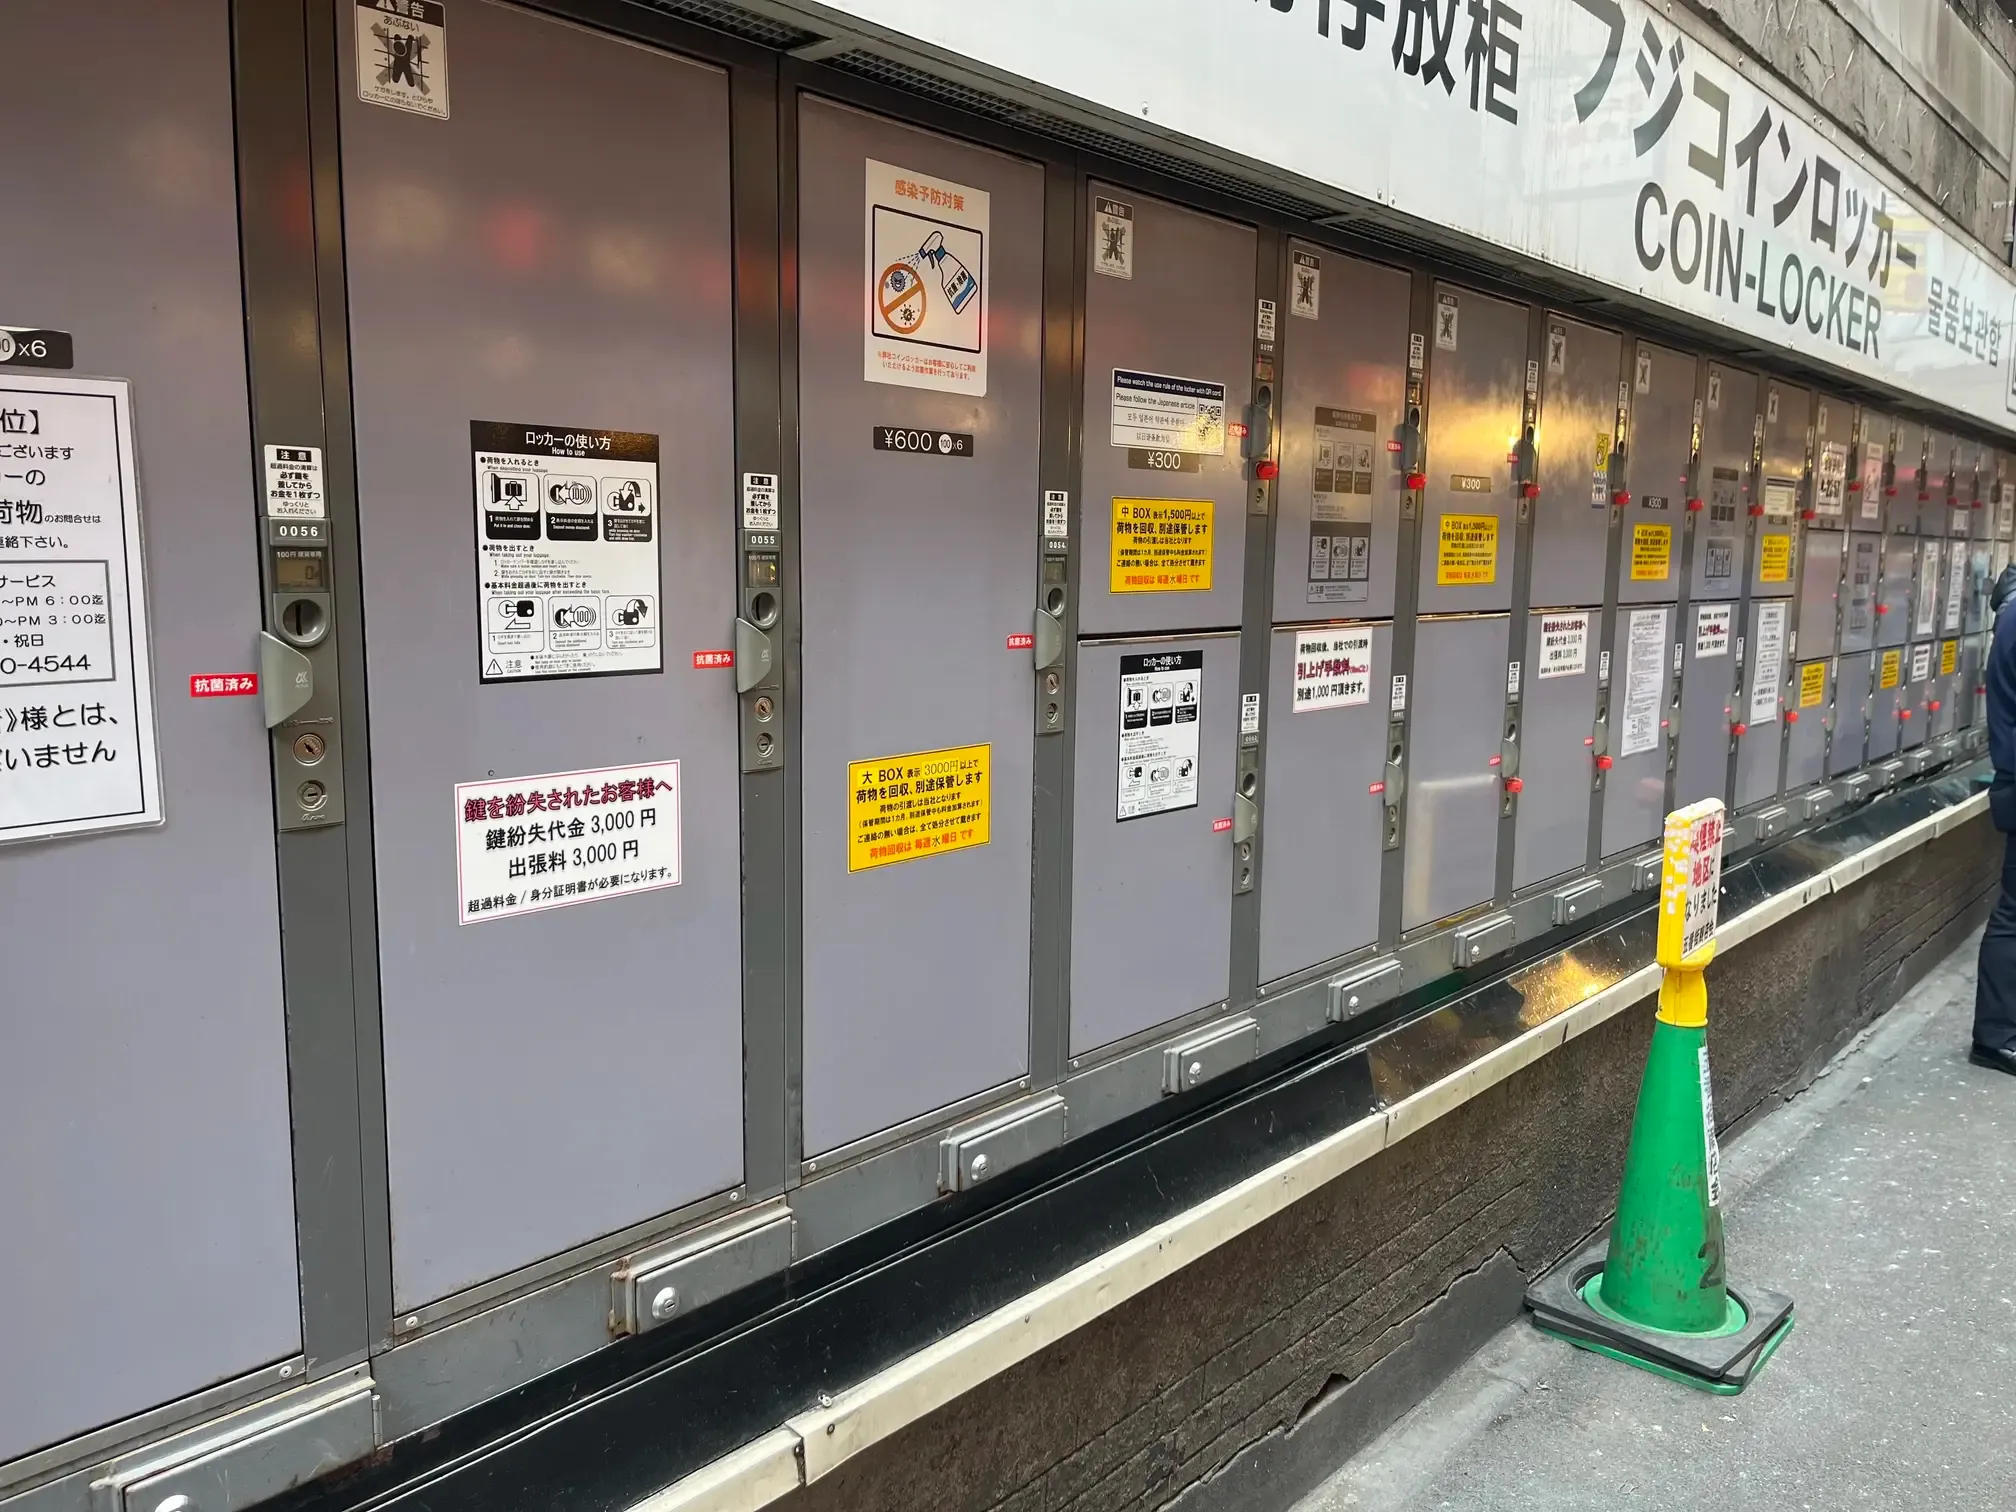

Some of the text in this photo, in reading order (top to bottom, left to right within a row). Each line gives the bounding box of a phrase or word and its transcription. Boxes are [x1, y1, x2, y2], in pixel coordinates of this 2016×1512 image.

[383, 15, 420, 32] あぶない
[1573, 0, 1917, 290] フジコインロッカー
[895, 179, 965, 212] 感染予防対策
[1634, 182, 1882, 361] COIN-LOCKER
[1928, 276, 2002, 368] 물품보관함
[1117, 376, 1132, 386] Please
[1146, 380, 1154, 388] the
[1116, 393, 1196, 410] Please follow the Japanese article
[525, 431, 612, 452] ロッカーの使い方
[884, 429, 933, 452] ¥600
[552, 447, 566, 455] How
[574, 449, 586, 457] use
[1147, 451, 1182, 470] ¥300
[487, 457, 540, 466] 荷物を入れるとき
[1461, 477, 1481, 490] ¥300
[1121, 505, 1129, 519] 中
[1133, 507, 1151, 519] BOX
[279, 525, 319, 537] 0056
[1117, 522, 1208, 535] 荷物を回収、別途保管します
[489, 544, 535, 552] 荷物を出すとき
[751, 535, 775, 546] 0055
[491, 581, 587, 589] 基本料金超過後に荷物を出すとき
[695, 652, 732, 666] 抗菌済み
[1143, 655, 1182, 667] ロッカーの使い方
[195, 677, 254, 694] 抗菌済み
[862, 770, 873, 785] 大
[878, 767, 904, 783] BOX
[856, 771, 984, 805] 荷物を回収、別途保管します
[464, 777, 673, 823] 鍵を紛失されたお客様へ
[880, 792, 962, 814] 荷物の引渡しは当社となります
[486, 808, 657, 851] 鍵紛失代金 3,000 円
[869, 828, 975, 861] 荷物回収は 毎週水曜日 です
[508, 840, 639, 879] 出張料 3,000 円
[1692, 855, 1715, 888] 地区に
[467, 893, 517, 914] 超過料金
[530, 865, 673, 902] 身分証明書が必要になります。
[1685, 882, 1718, 923] なりました
